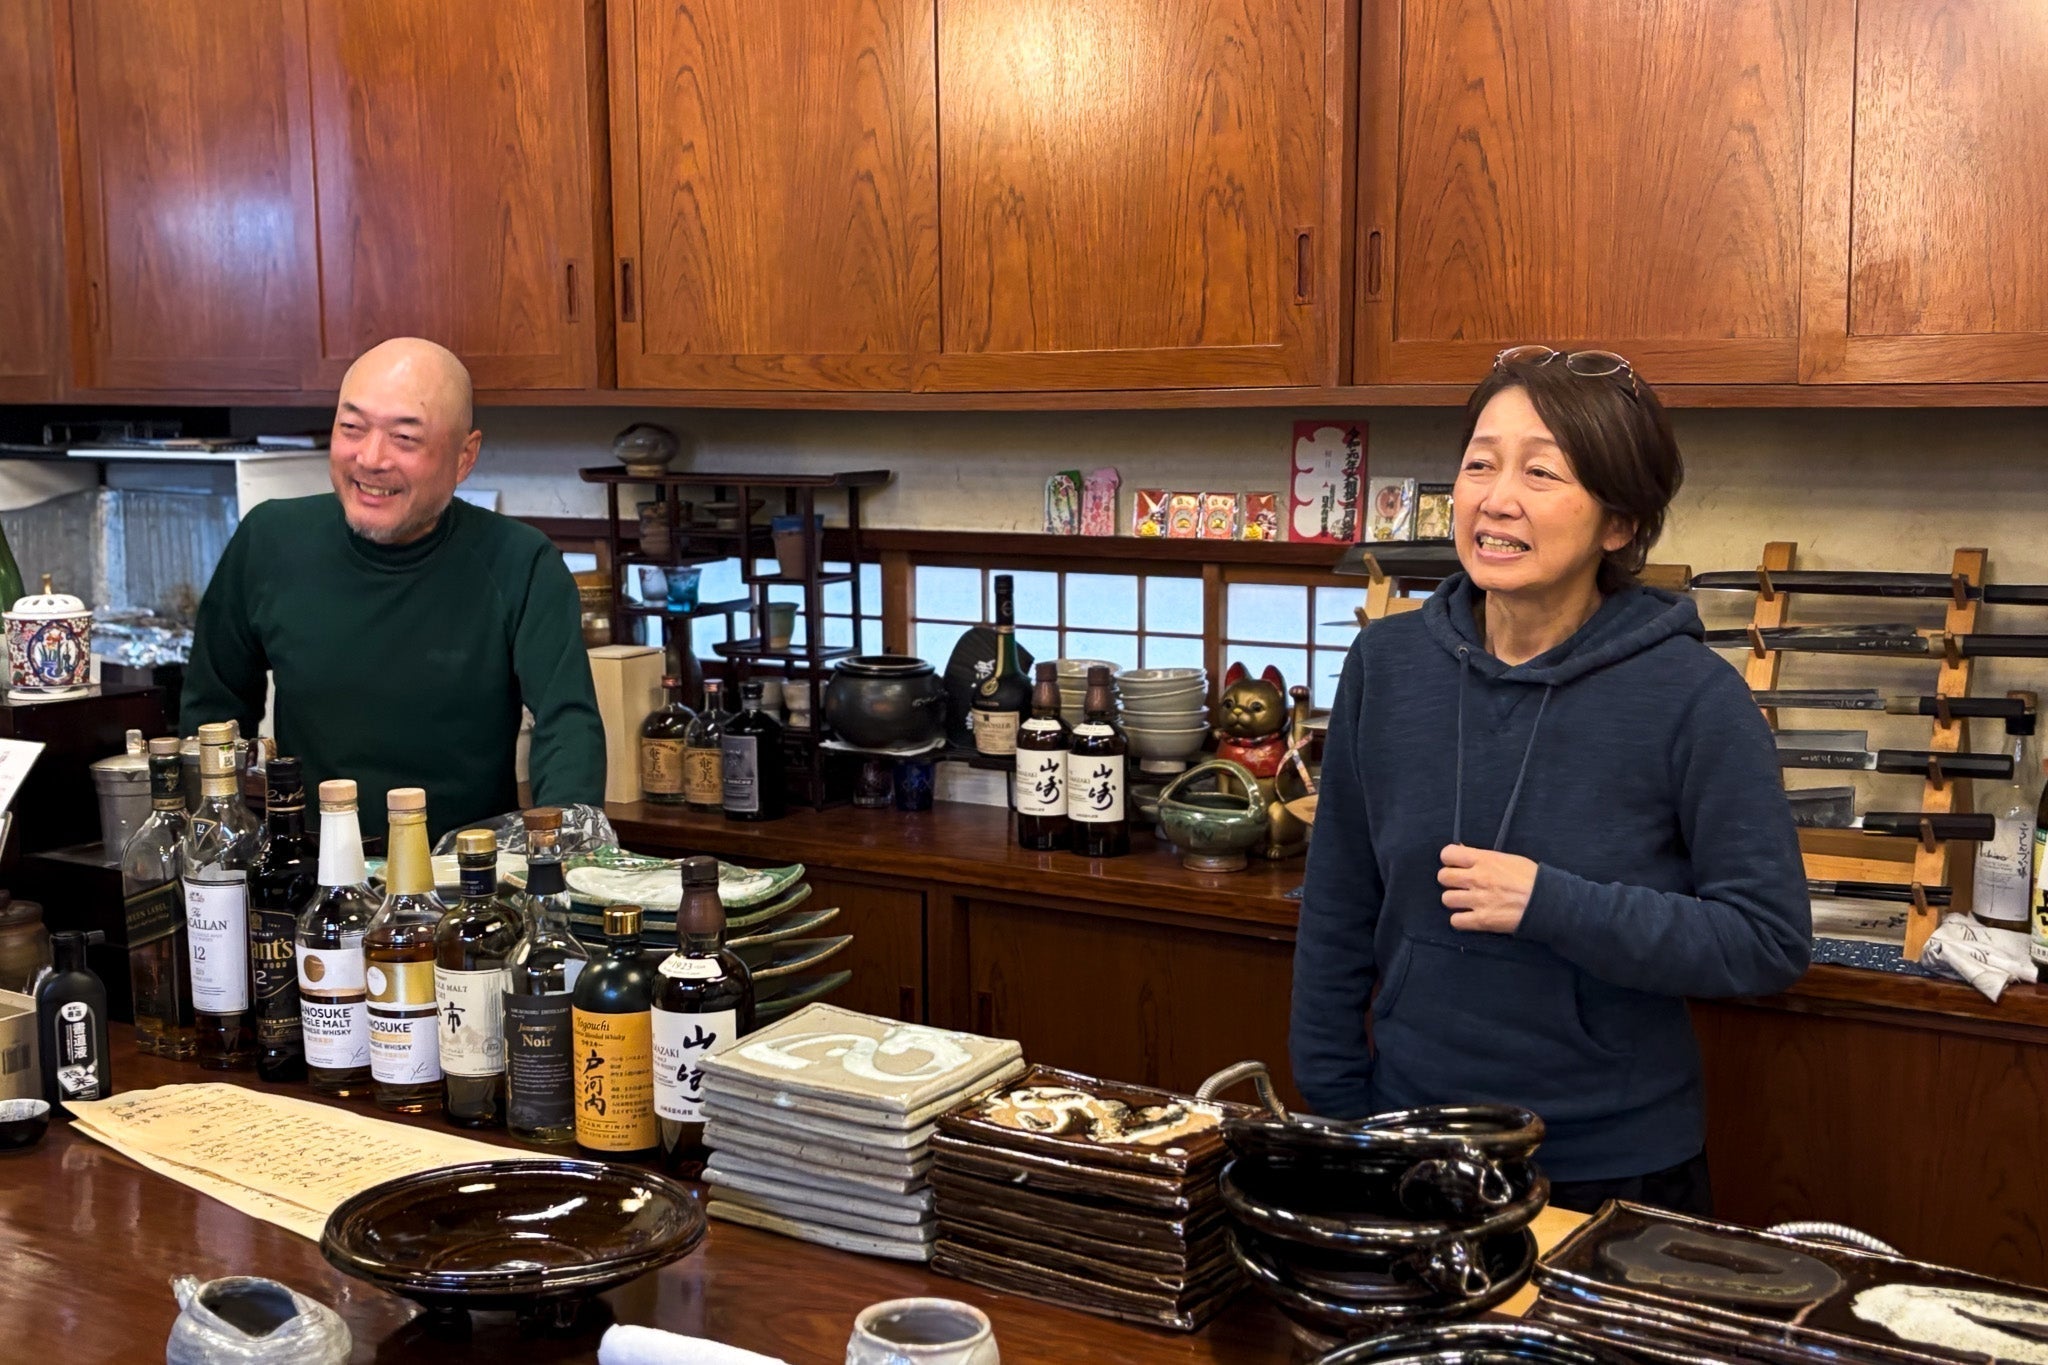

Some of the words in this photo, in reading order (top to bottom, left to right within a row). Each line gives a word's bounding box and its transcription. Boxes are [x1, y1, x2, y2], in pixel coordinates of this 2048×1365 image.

[1035, 757, 1063, 804] 山崎
[1088, 763, 1117, 811] 山崎
[193, 945, 206, 961] 12
[322, 1019, 351, 1028] MALT
[522, 1033, 552, 1047] Noir
